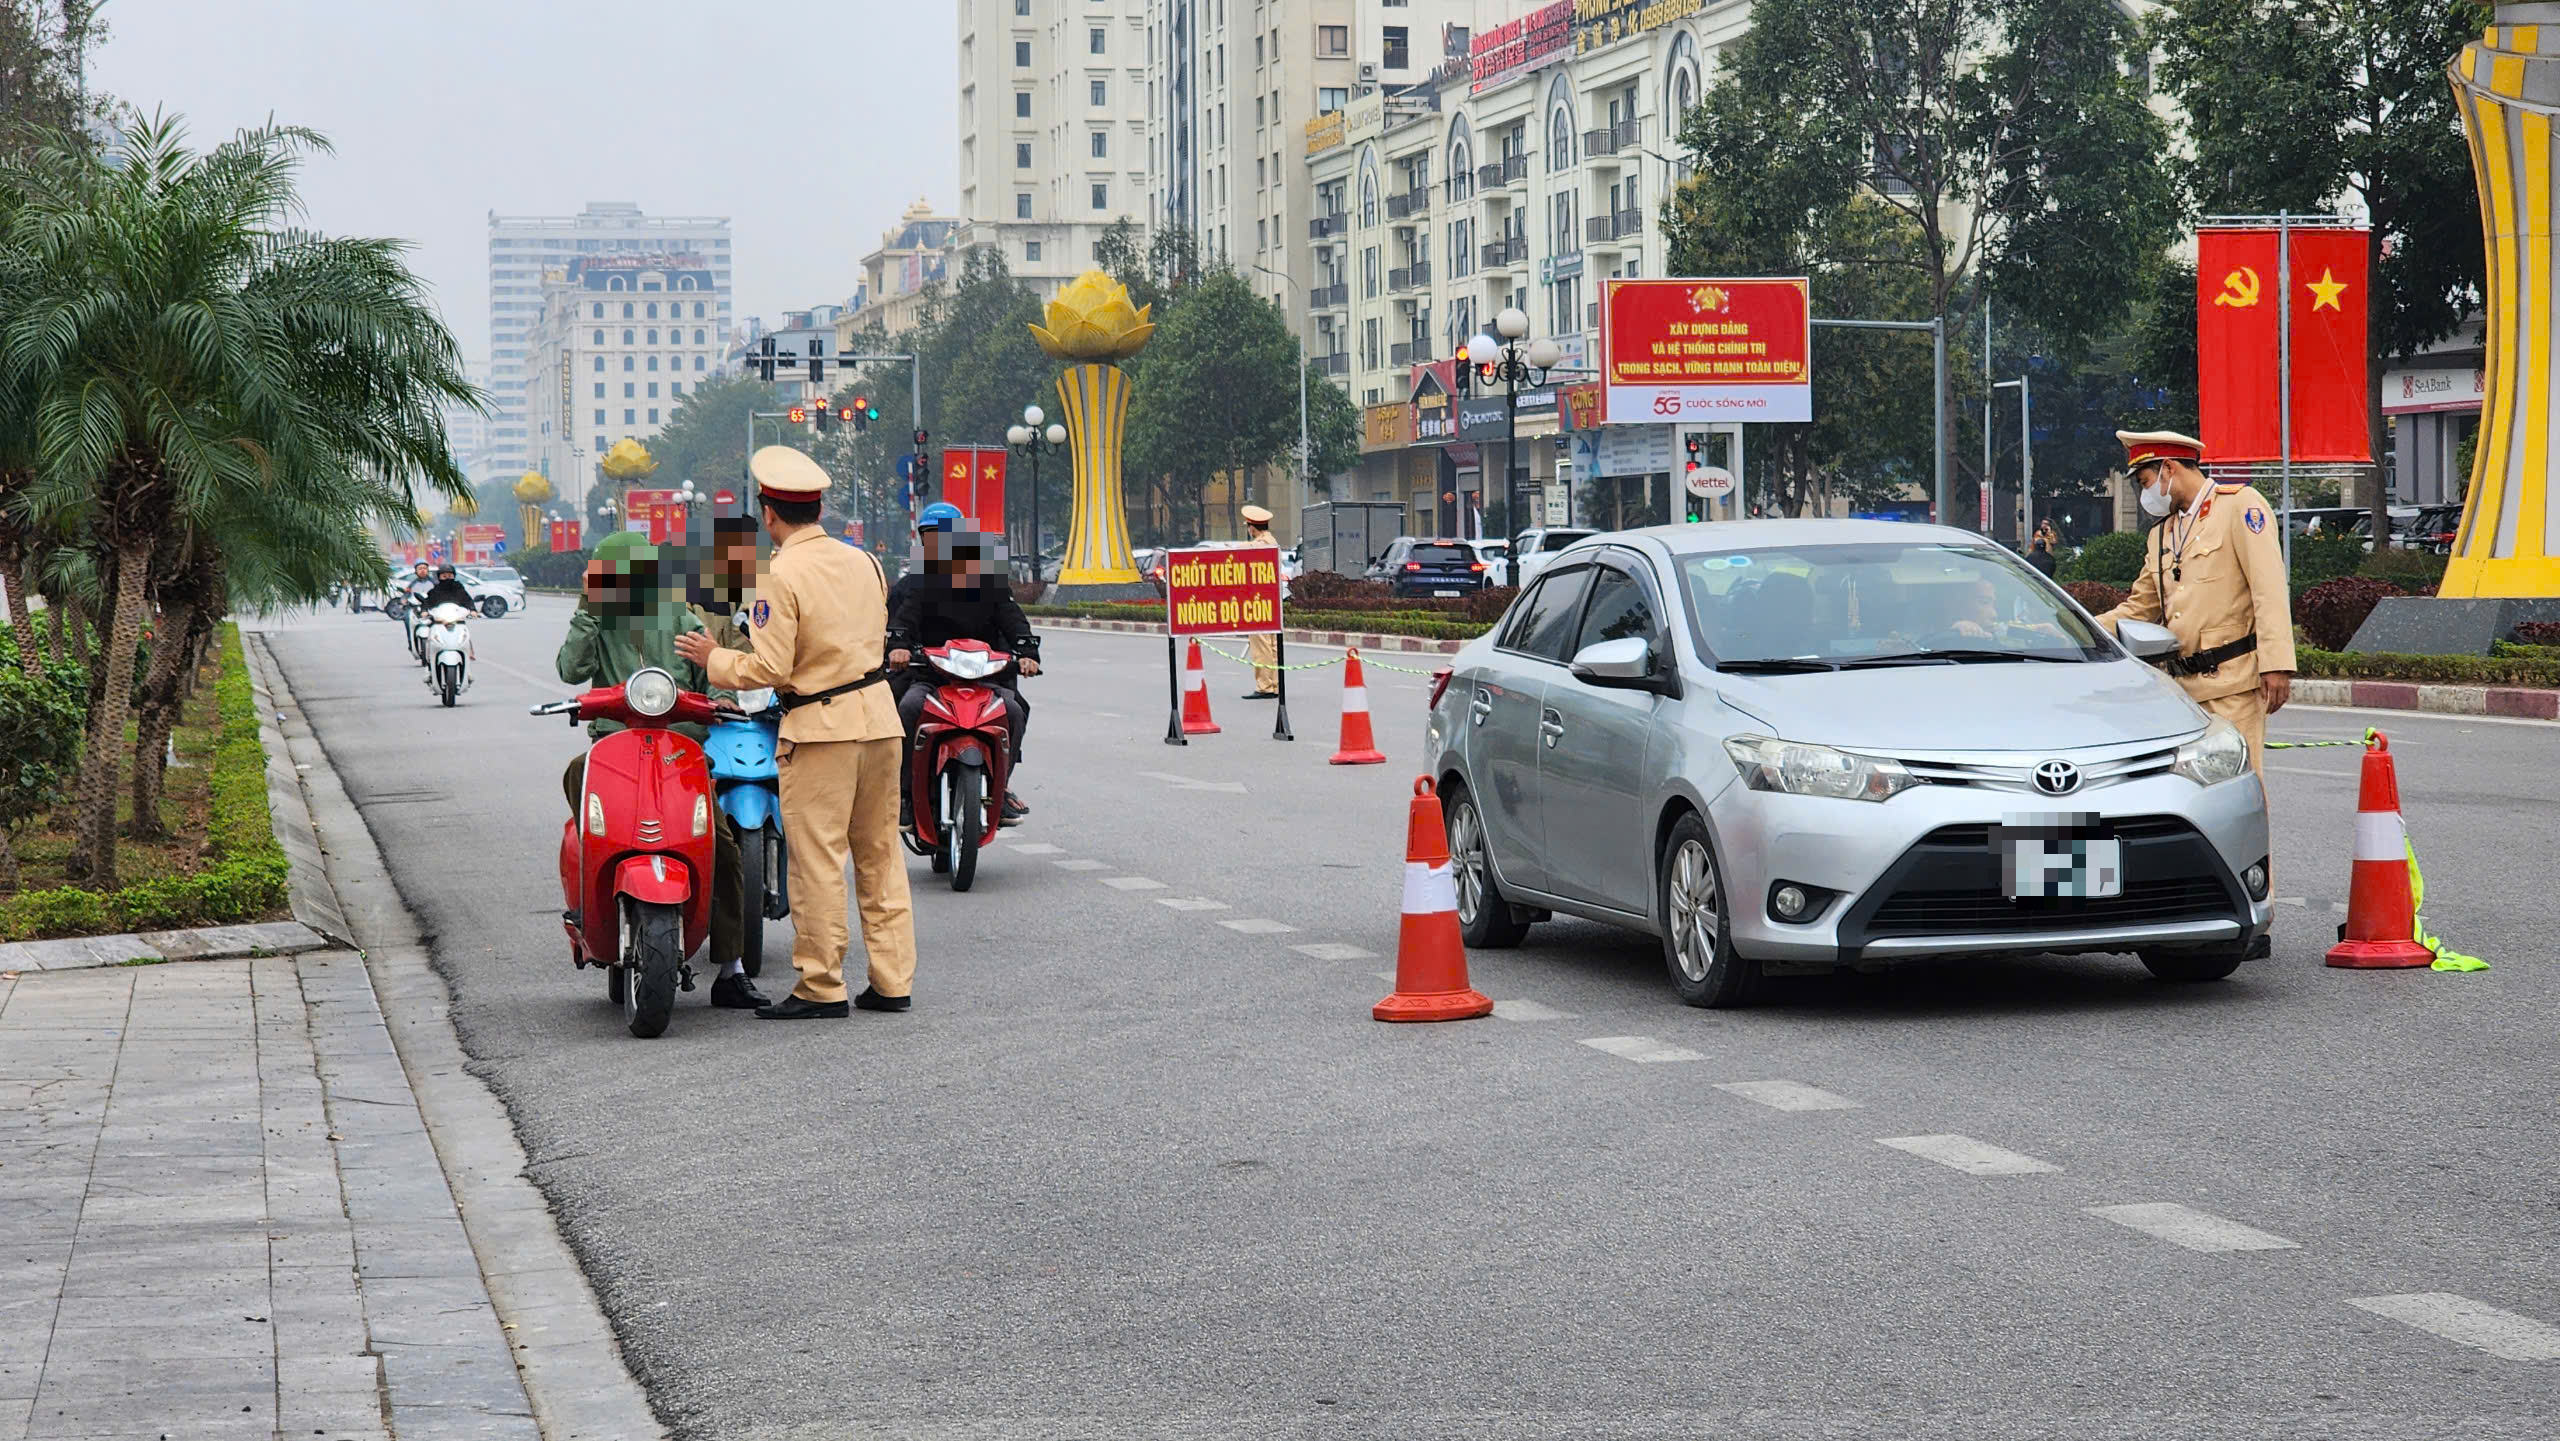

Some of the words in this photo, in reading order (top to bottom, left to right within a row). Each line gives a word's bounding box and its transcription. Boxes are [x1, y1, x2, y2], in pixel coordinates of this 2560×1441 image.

[1669, 321, 1689, 336] XÂY
[1691, 322, 1719, 337] DỰNG
[1721, 320, 1748, 336] ĐẢNG
[1652, 341, 1666, 355] VÀ
[1668, 340, 1681, 357] HỆ
[1683, 340, 1715, 355] THỐNG
[1717, 341, 1748, 355] CHÍNH
[1750, 342, 1766, 357] TRỊ
[1618, 362, 1650, 375] TRONG
[1684, 360, 1711, 374] VỮNG
[1713, 361, 1743, 376] MẠNH
[1745, 360, 1772, 374] TOÀN
[2414, 376, 2452, 394] SeABank
[1653, 396, 1681, 415] 5G
[1686, 399, 1713, 409] CUỘC
[1716, 398, 1744, 409] SỐNG
[1746, 399, 1767, 409] MỚI
[1691, 477, 1730, 488] viettel
[1171, 556, 1207, 588] CHỐT
[1211, 554, 1246, 586] KIỂM
[1249, 561, 1276, 585] TRA
[1177, 594, 1217, 626] NỒNG
[1220, 595, 1240, 628] ĐỘ
[1243, 592, 1272, 623] CỒN
